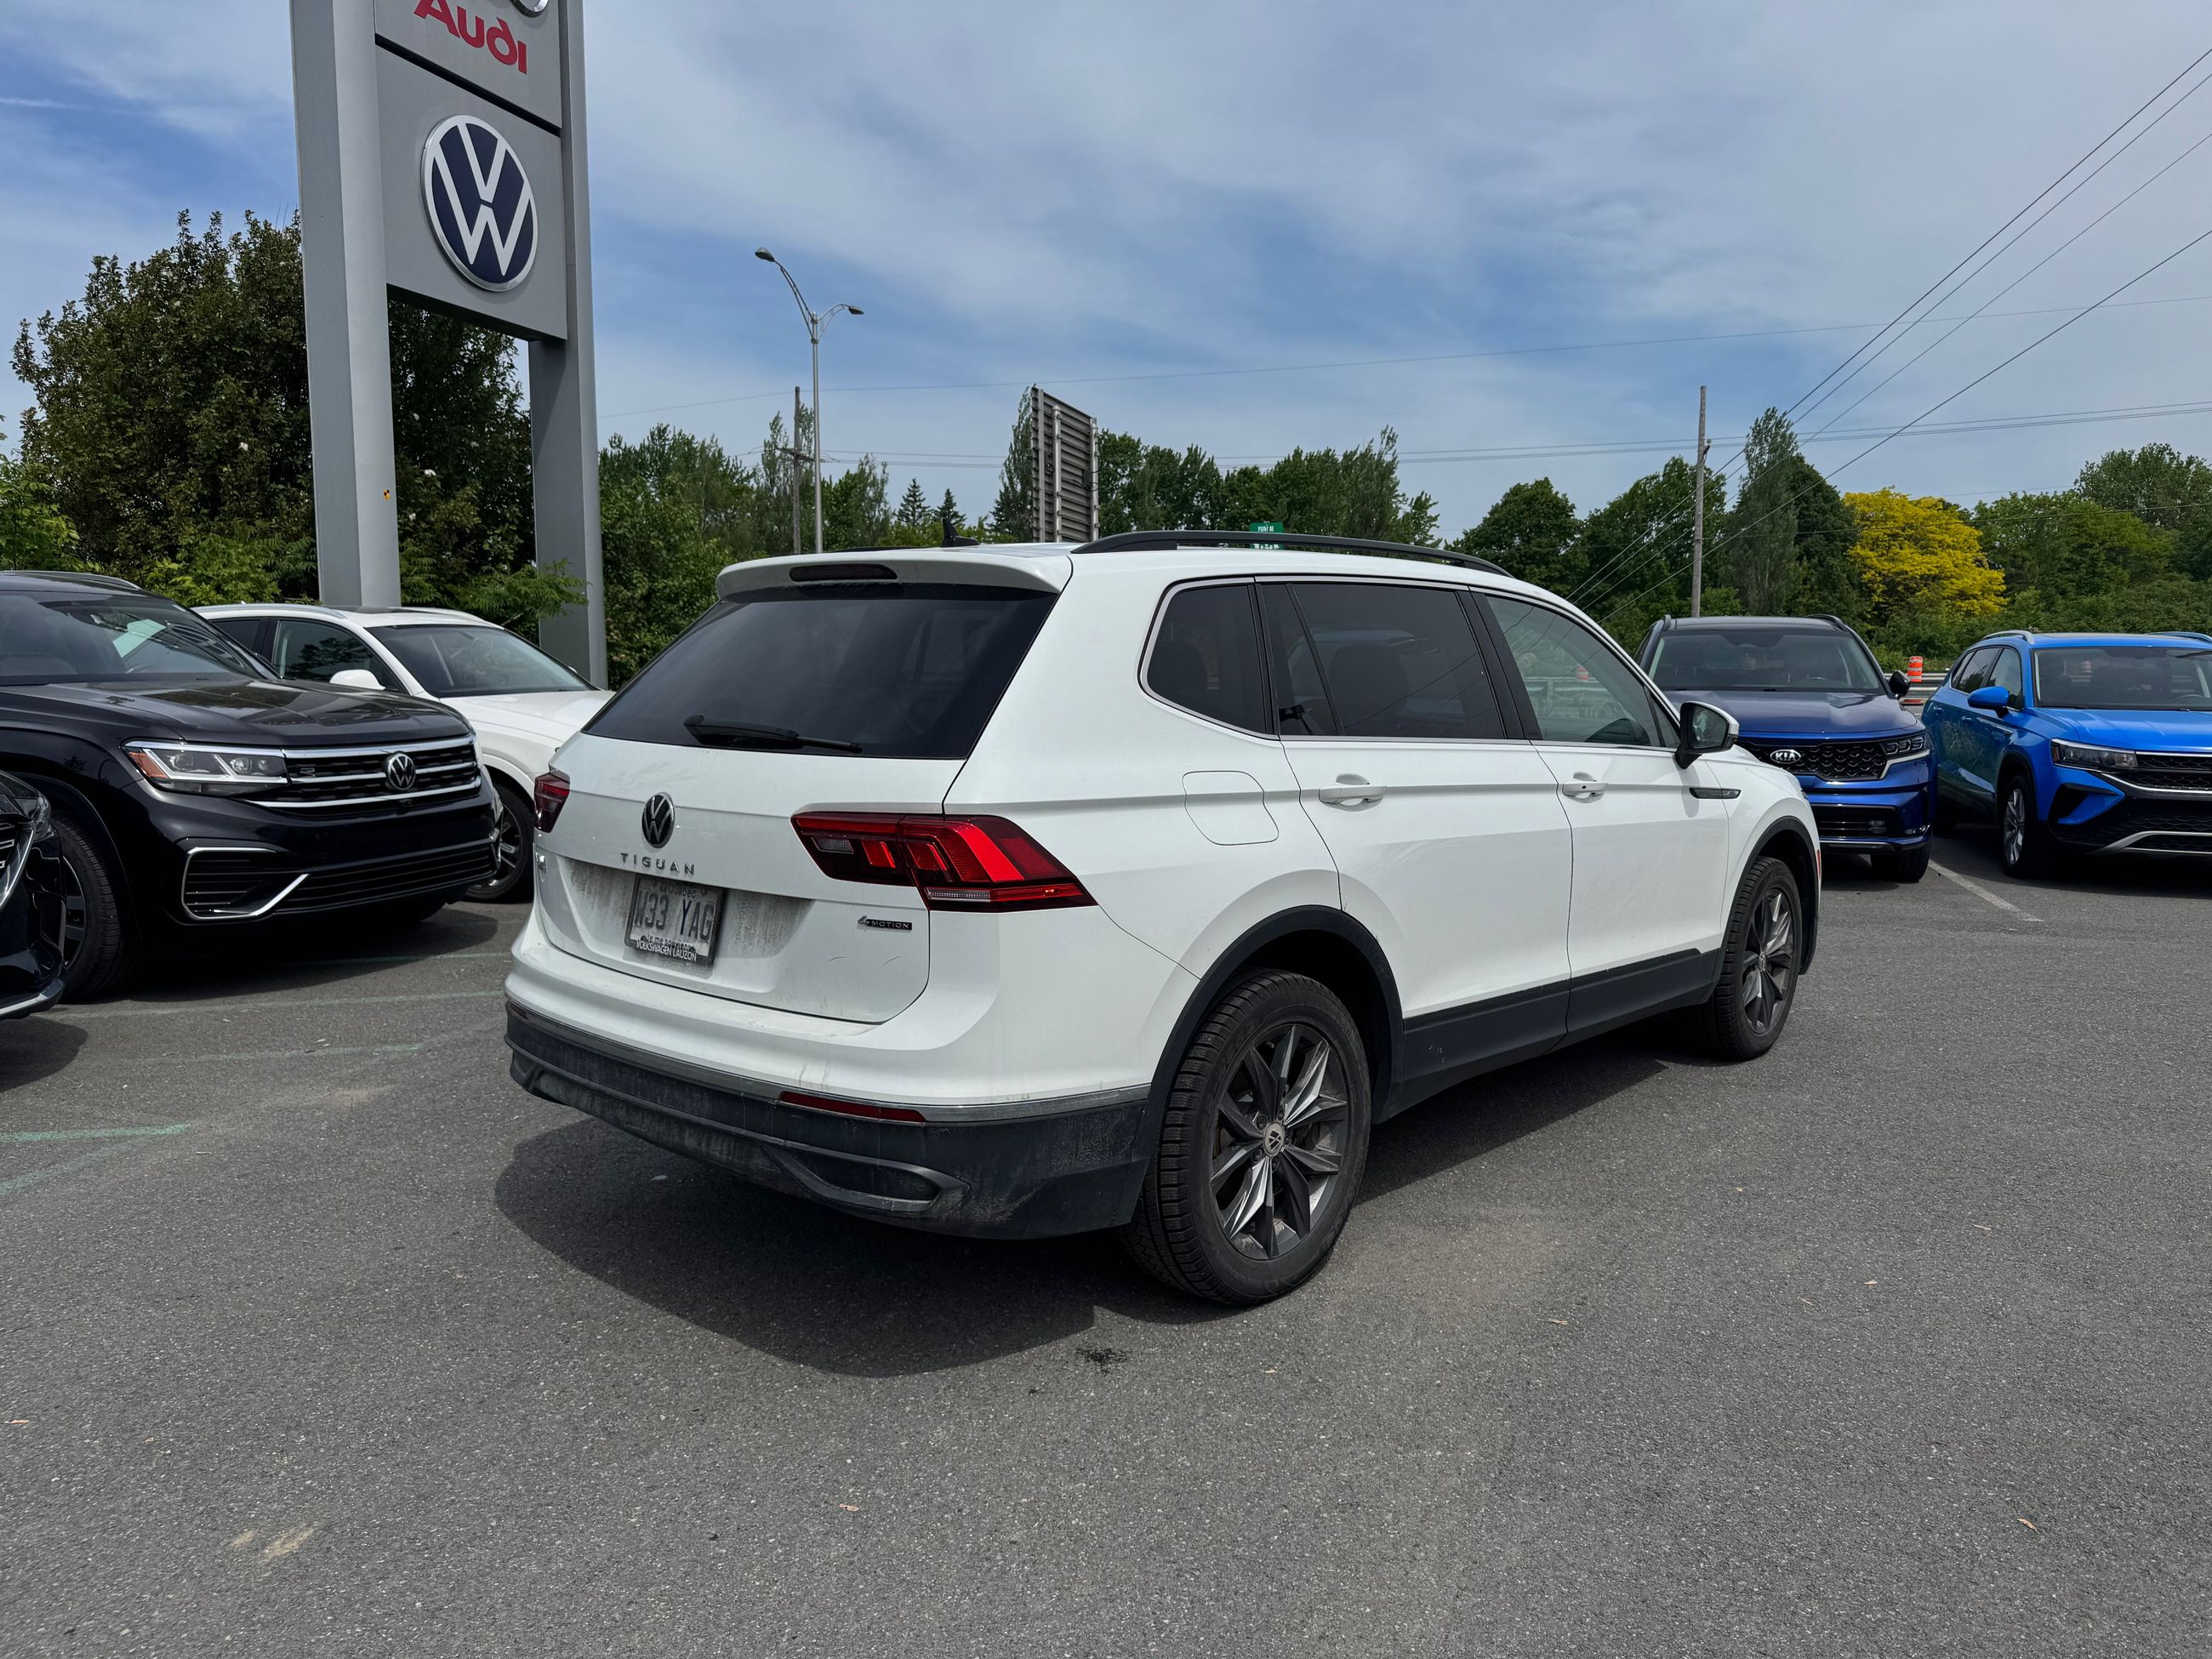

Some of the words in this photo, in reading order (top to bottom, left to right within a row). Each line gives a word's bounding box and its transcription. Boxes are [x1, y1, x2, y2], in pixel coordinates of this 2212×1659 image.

[413, 0, 527, 75] Audi
[425, 117, 535, 286] VW
[1774, 751, 1797, 762] KIA
[620, 852, 695, 875] TIGUAN
[680, 898, 715, 941] YAG
[636, 939, 672, 956] VOLKSWAGEN
[673, 947, 697, 962] LAUZON
